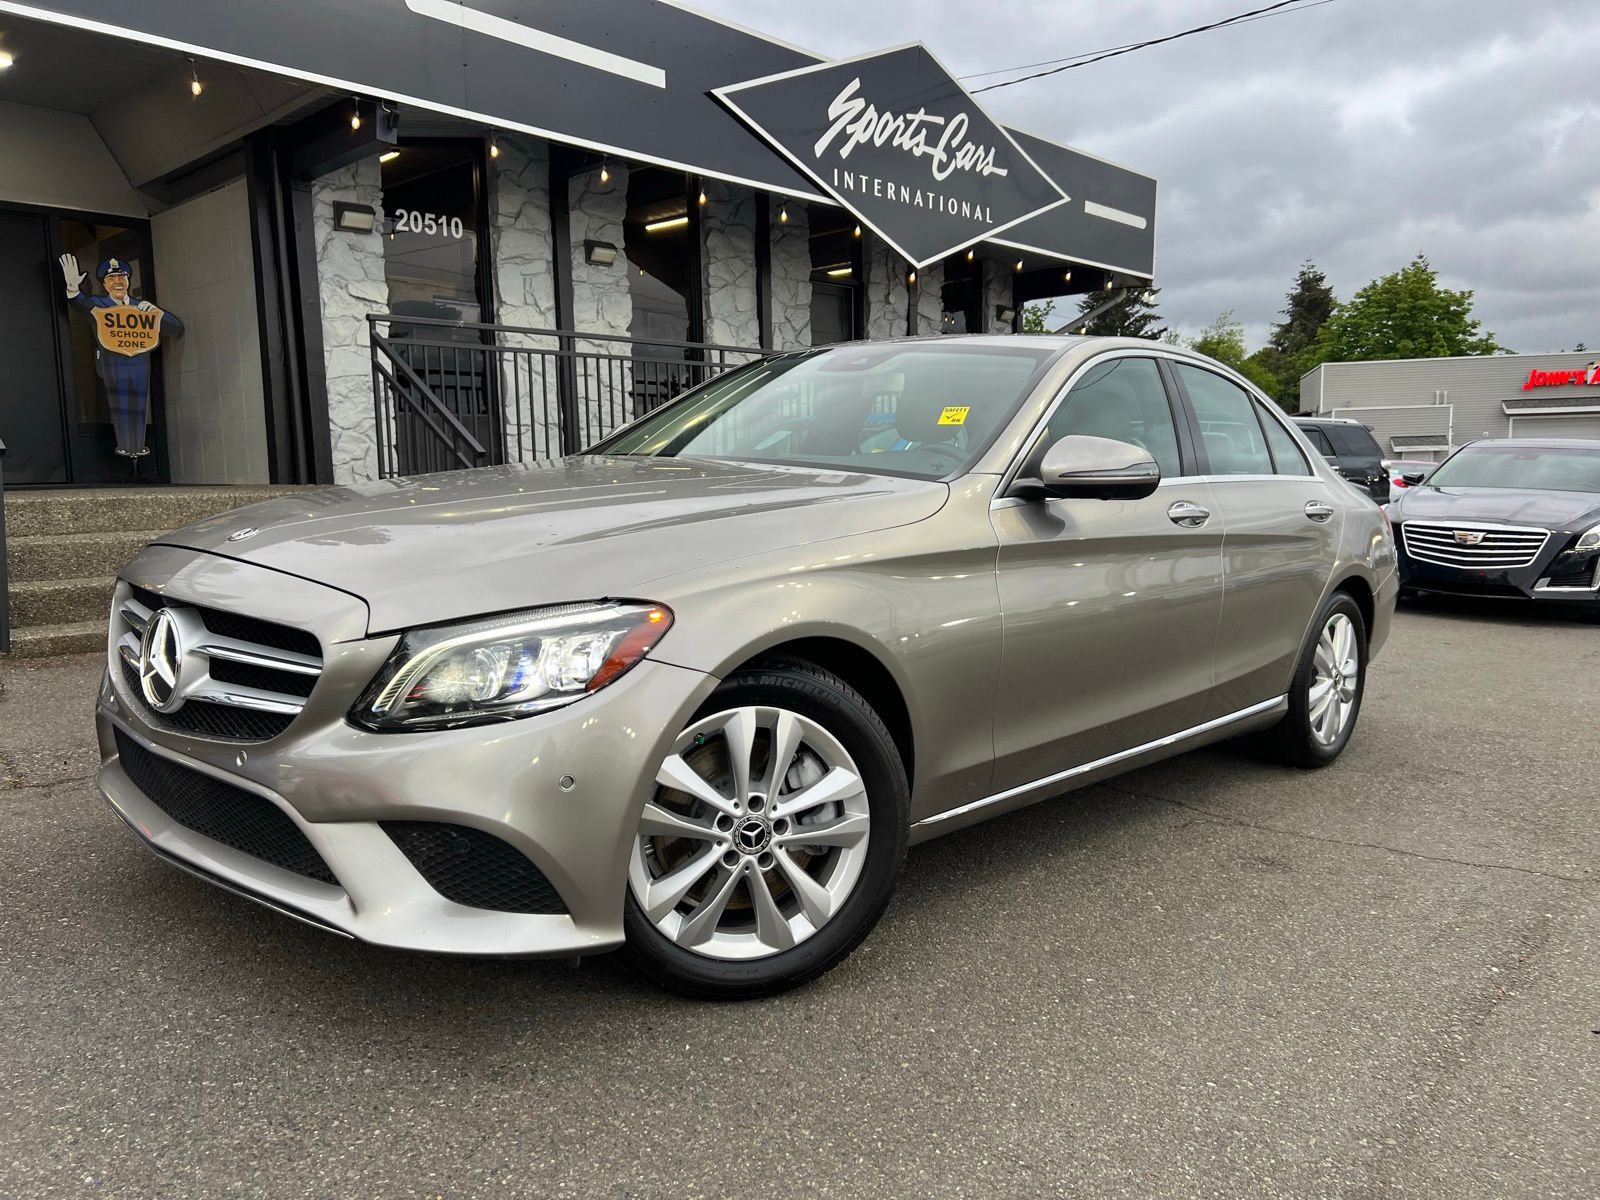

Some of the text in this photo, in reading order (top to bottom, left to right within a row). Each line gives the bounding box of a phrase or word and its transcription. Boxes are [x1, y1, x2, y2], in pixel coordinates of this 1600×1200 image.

[814, 77, 1008, 181] Sports Cars
[833, 168, 993, 223] INTERNATIONAL
[395, 208, 464, 239] 20510
[104, 313, 156, 330] SLOW
[110, 331, 153, 339] SCHOOL
[117, 340, 146, 348] ZONE
[759, 675, 842, 705] MICHELIN
